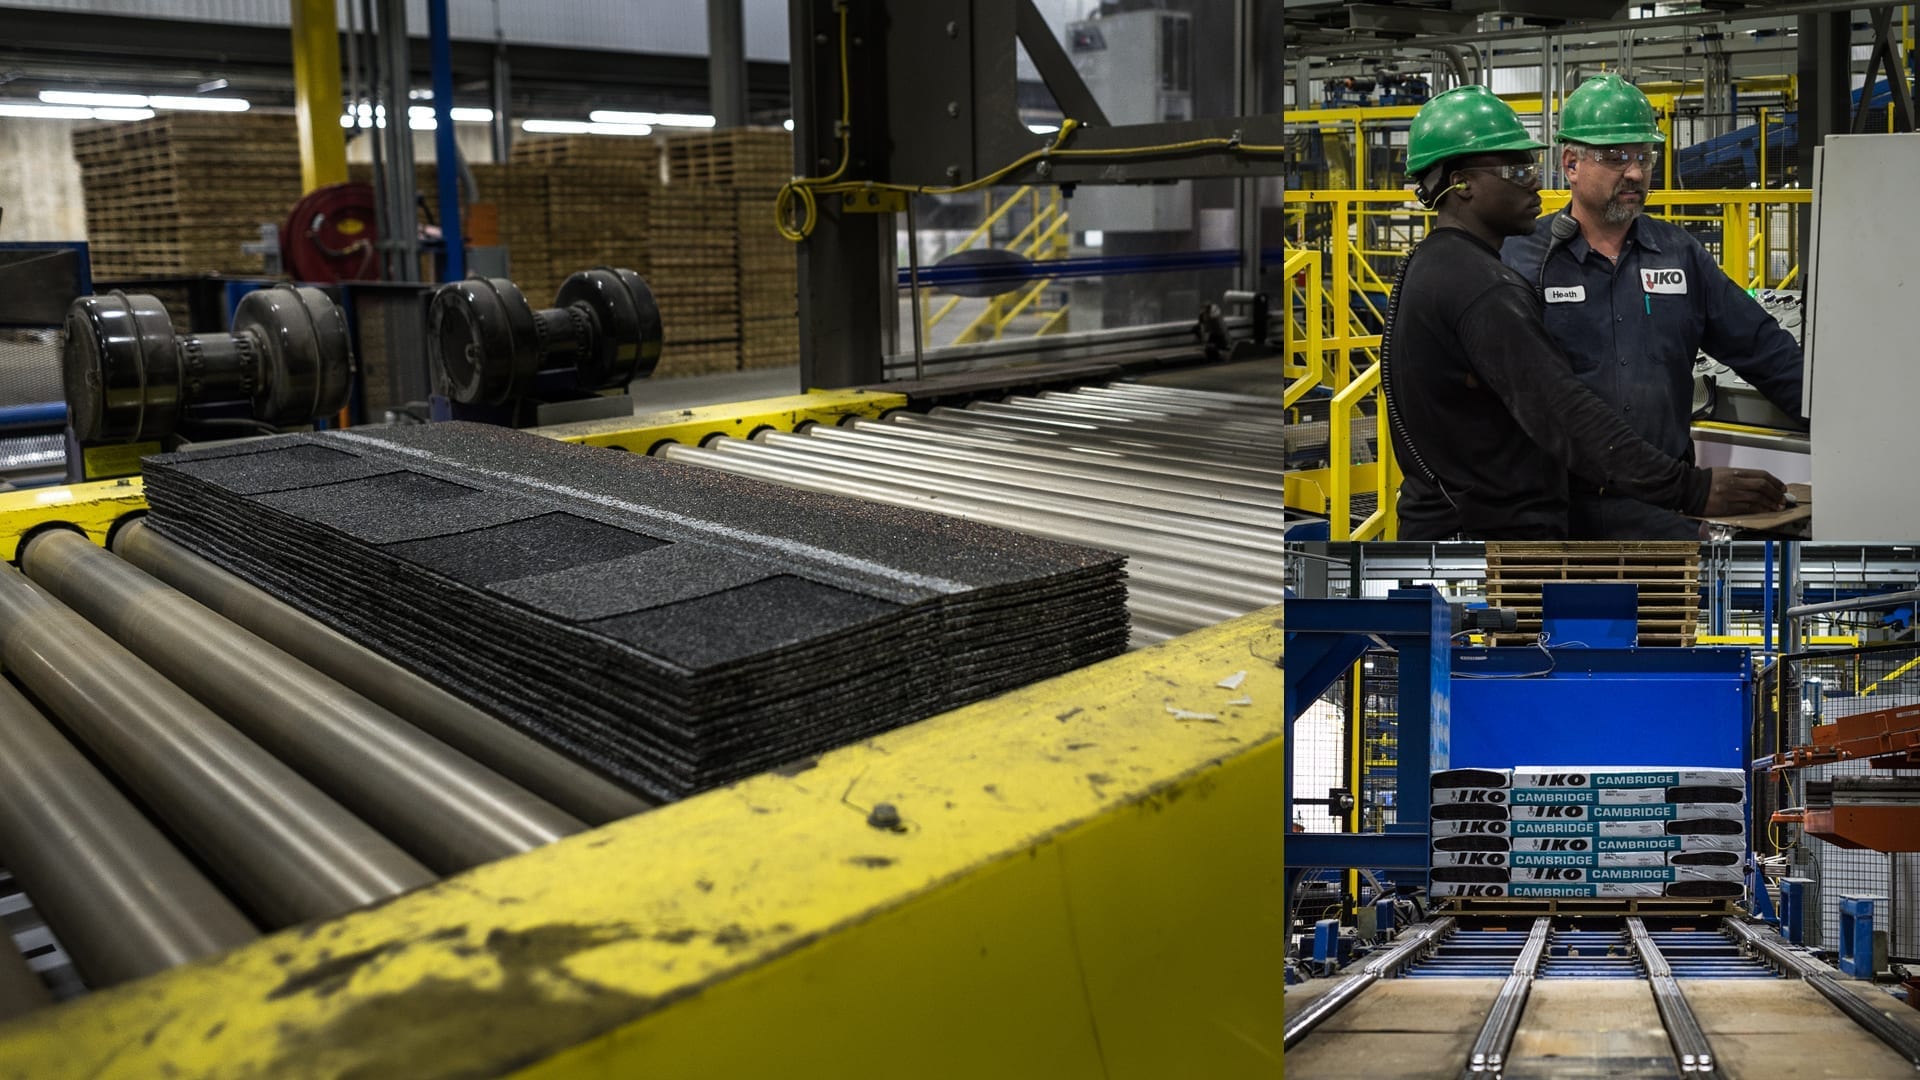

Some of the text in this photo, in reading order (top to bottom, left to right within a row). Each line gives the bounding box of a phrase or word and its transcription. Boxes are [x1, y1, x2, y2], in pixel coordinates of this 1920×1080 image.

[1654, 271, 1683, 285] IKO
[1553, 290, 1577, 298] Heath
[1538, 773, 1586, 786] IKO
[1596, 775, 1674, 785] CAMBRIDGE
[1458, 790, 1506, 803] IKO
[1516, 793, 1593, 802] CAMBRIDGE
[1535, 806, 1671, 817] IKO CAMBRIDGE
[1458, 821, 1507, 833] IKO
[1517, 824, 1594, 833] CAMBRIDGE
[1540, 839, 1676, 851] IKO CAMBRIDGE
[1457, 852, 1506, 865] IKO
[1515, 855, 1593, 865] CAMBRIDGE
[1533, 868, 1583, 880] IKO
[1592, 869, 1670, 879] CAMBRIDGE
[1456, 884, 1591, 897] IKO CAMBRIDGE
